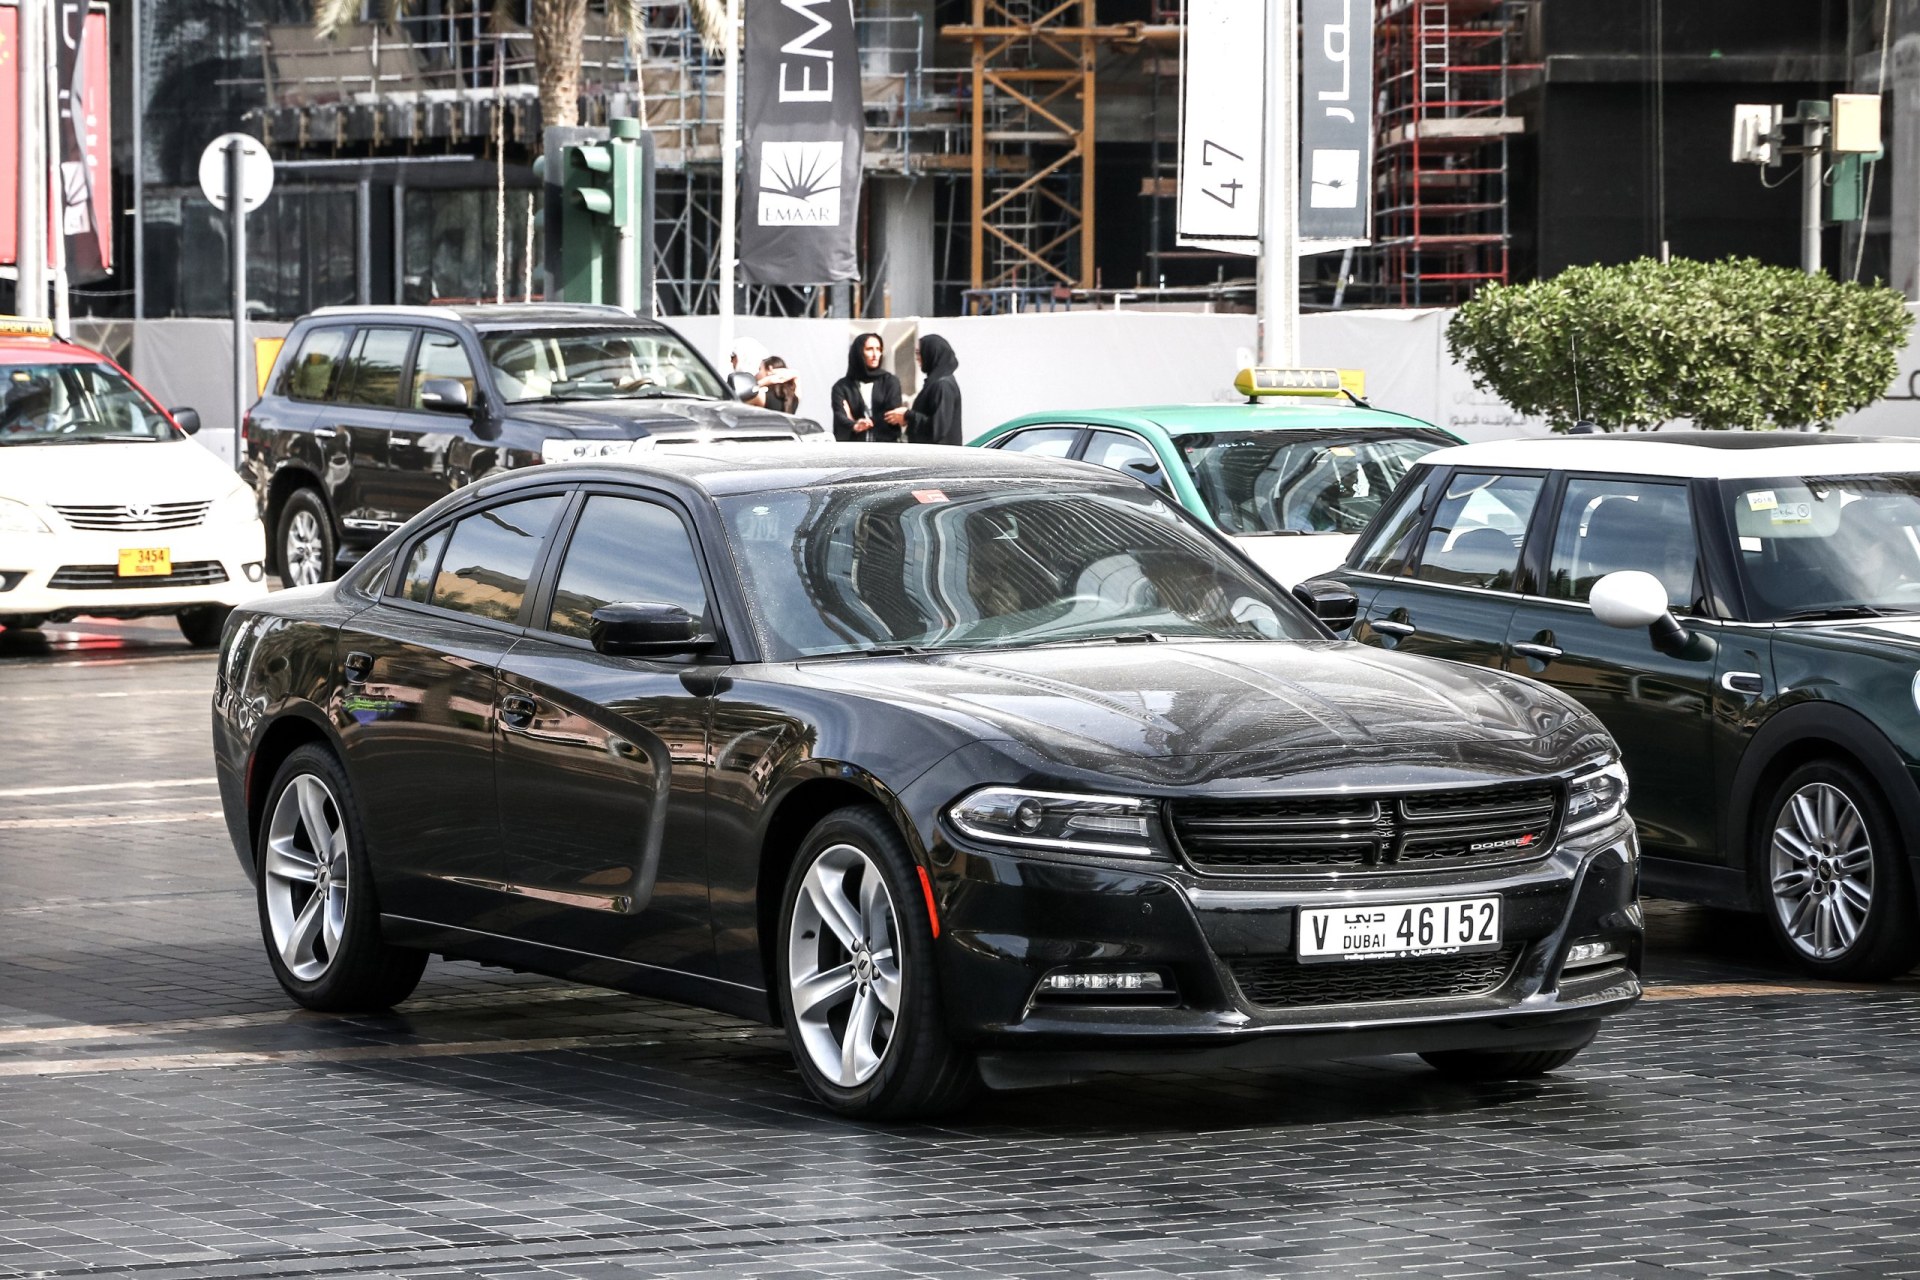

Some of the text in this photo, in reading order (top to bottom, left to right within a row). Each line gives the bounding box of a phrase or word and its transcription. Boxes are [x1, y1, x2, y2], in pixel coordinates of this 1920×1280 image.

[764, 207, 831, 222] EMAAR
[1265, 370, 1329, 387] TAXI
[138, 549, 165, 563] 3454
[1470, 838, 1524, 851] DODGE
[1344, 913, 1386, 930] دبي
[1396, 902, 1495, 947] 46152
[1312, 914, 1329, 951] V
[1343, 934, 1386, 950] DUBAI
